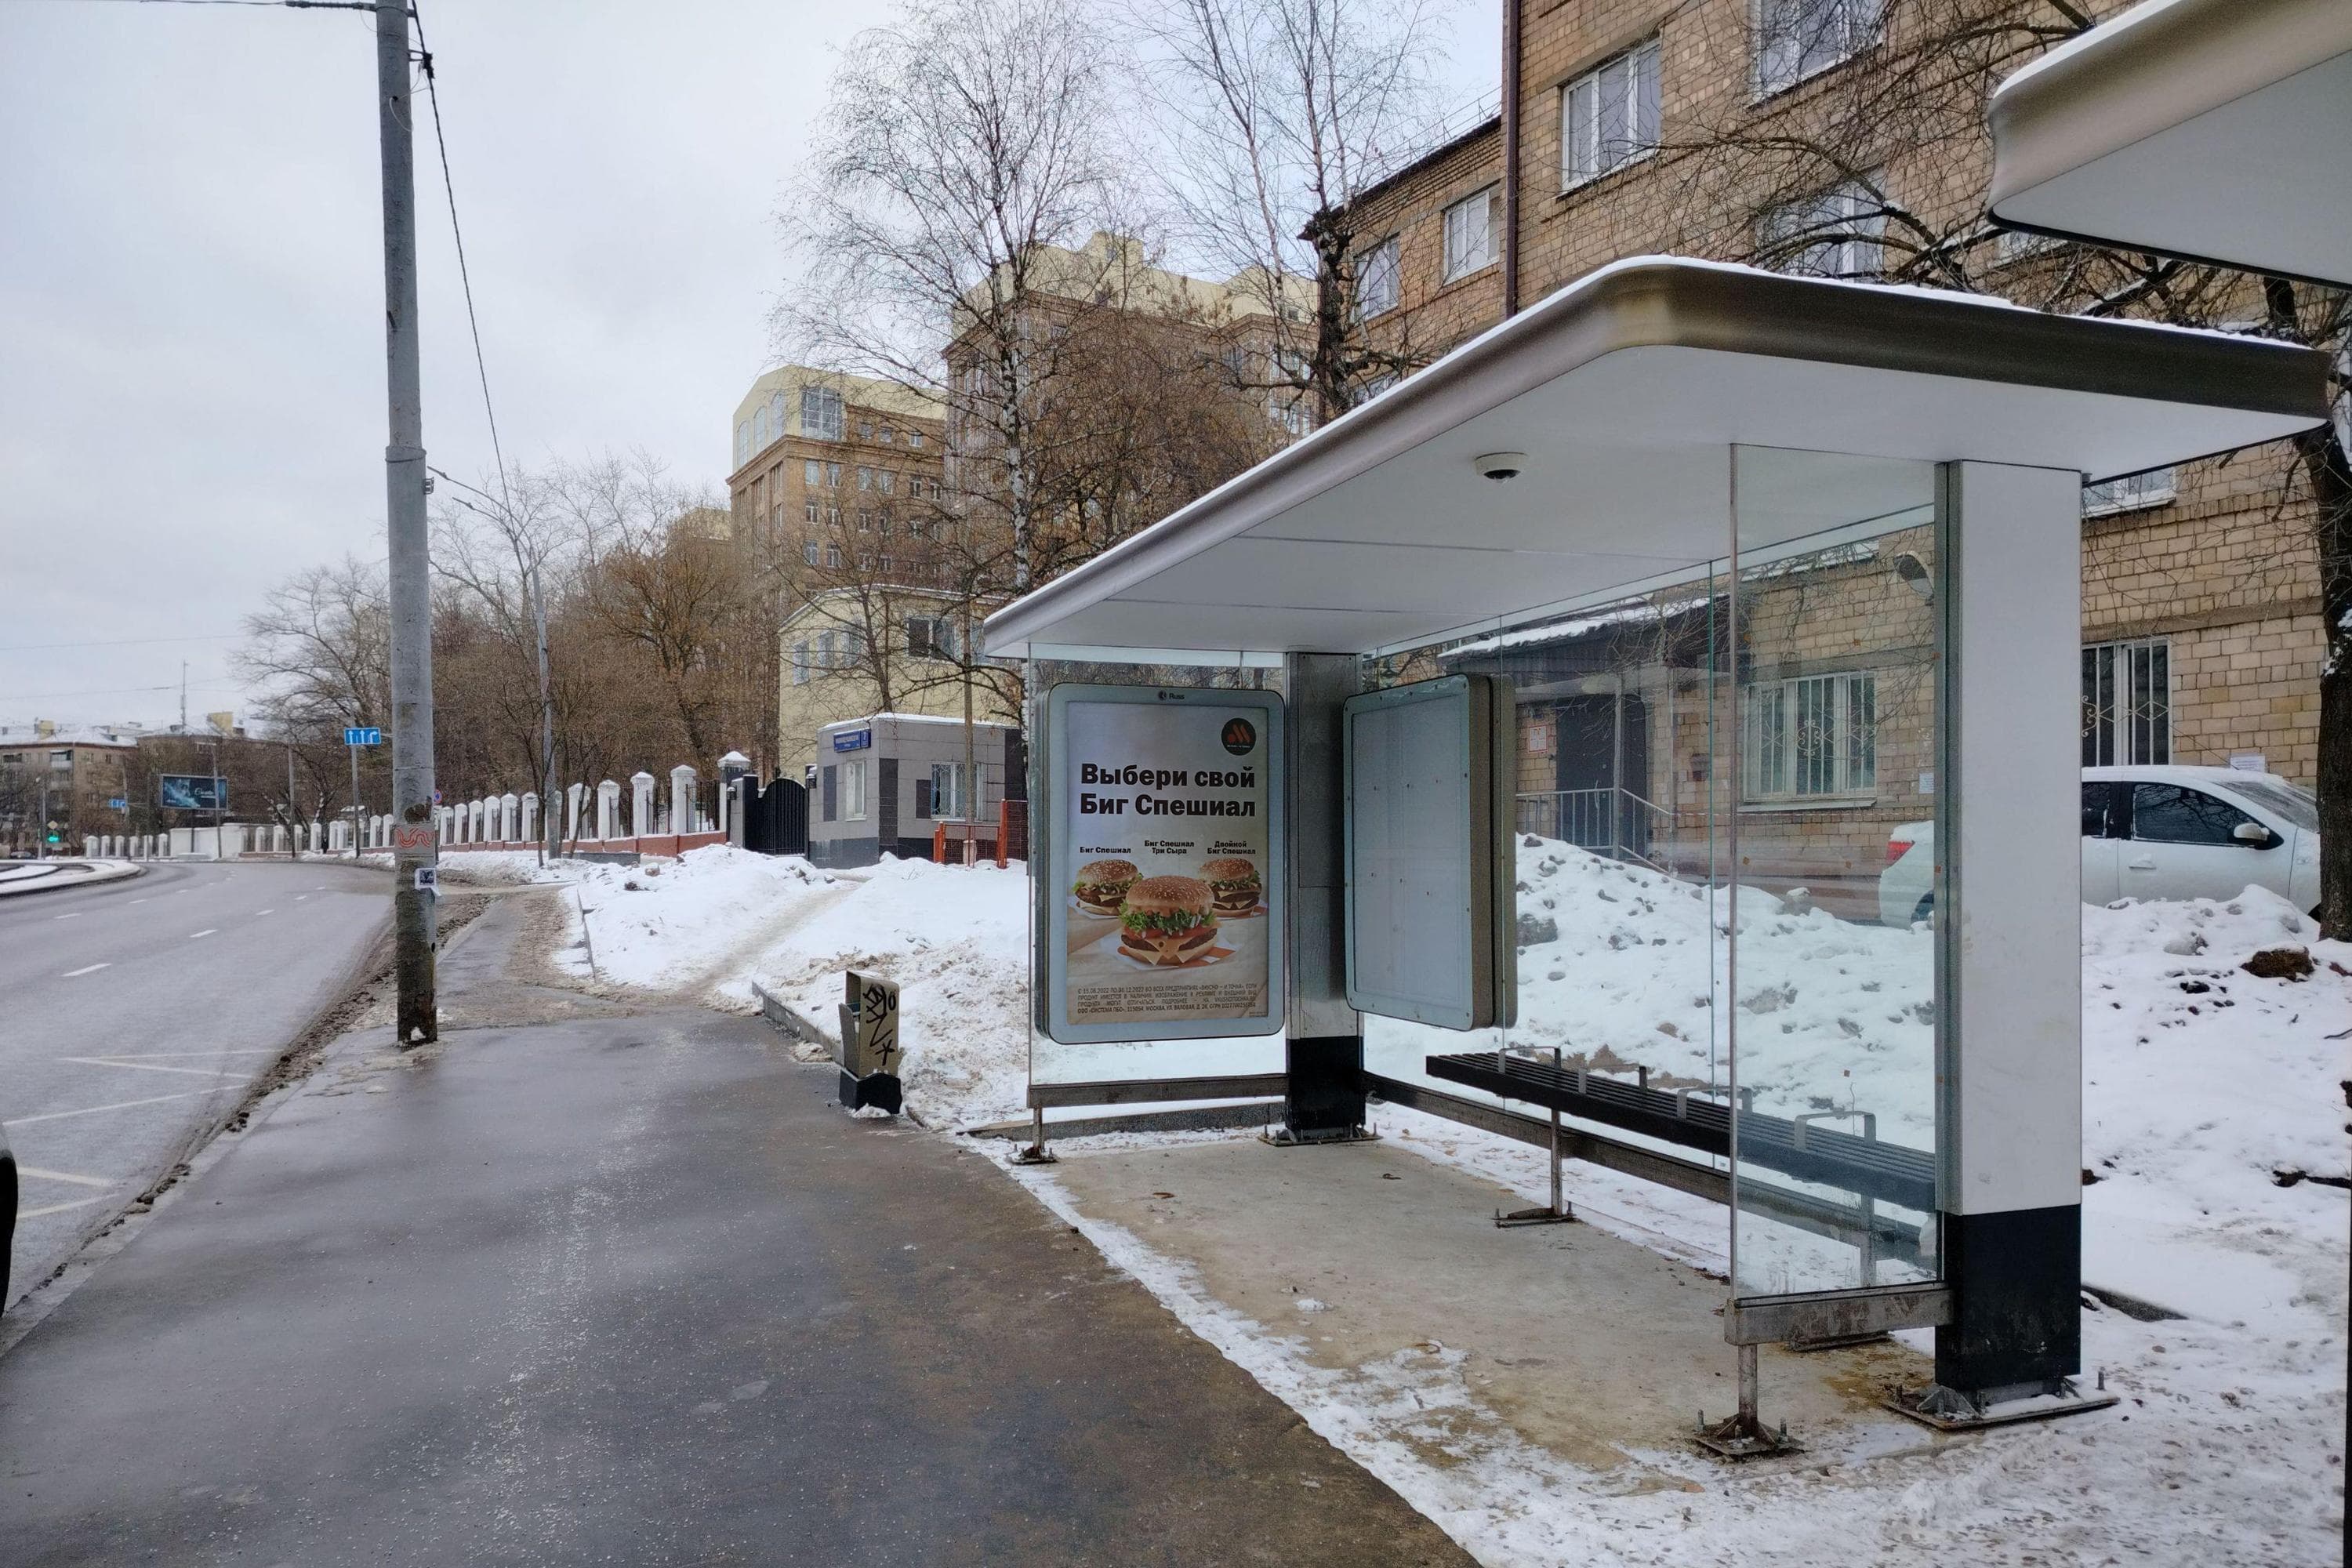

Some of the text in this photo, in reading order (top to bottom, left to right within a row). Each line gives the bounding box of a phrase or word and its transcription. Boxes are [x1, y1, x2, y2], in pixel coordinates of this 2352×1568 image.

[1081, 763, 1255, 790] Выбери свой
[1080, 793, 1255, 817] Биг Спешиал
